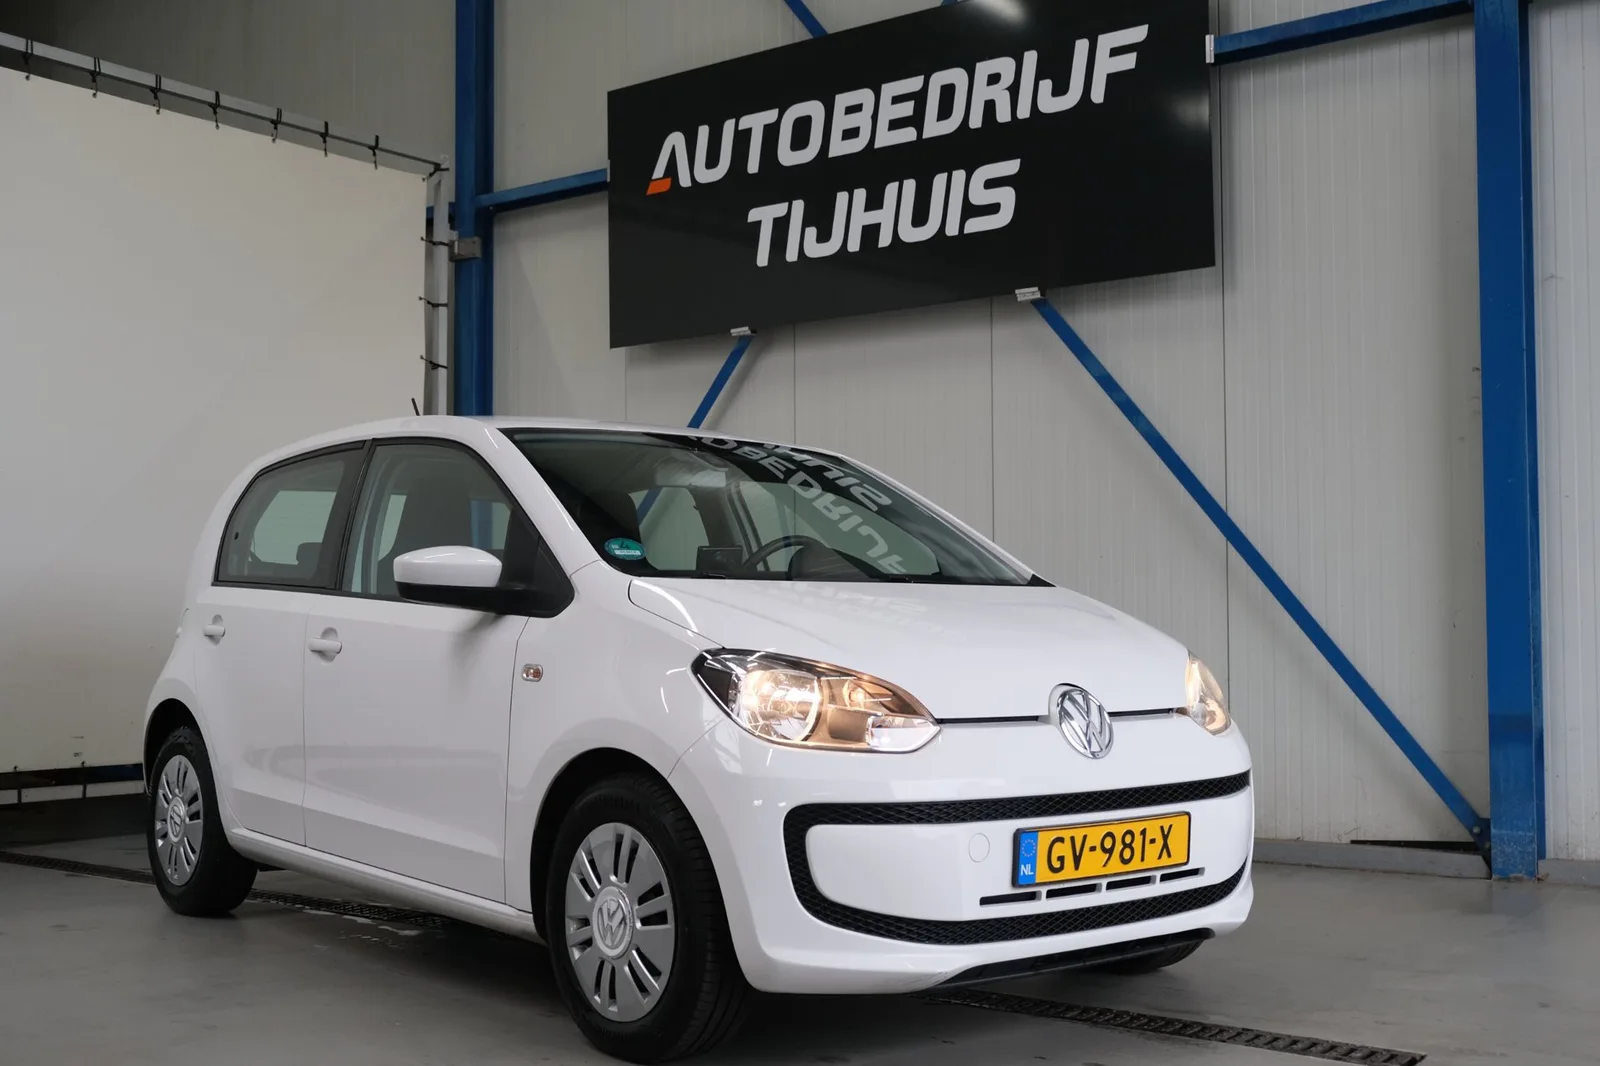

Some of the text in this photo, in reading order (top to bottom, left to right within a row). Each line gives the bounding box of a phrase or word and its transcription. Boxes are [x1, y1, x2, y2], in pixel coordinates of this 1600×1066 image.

[646, 24, 1149, 195] AUTOBEDRIJF
[747, 159, 1021, 267] TIJHUIS
[1020, 864, 1034, 876] NL
[1047, 824, 1173, 874] GV-981-X
